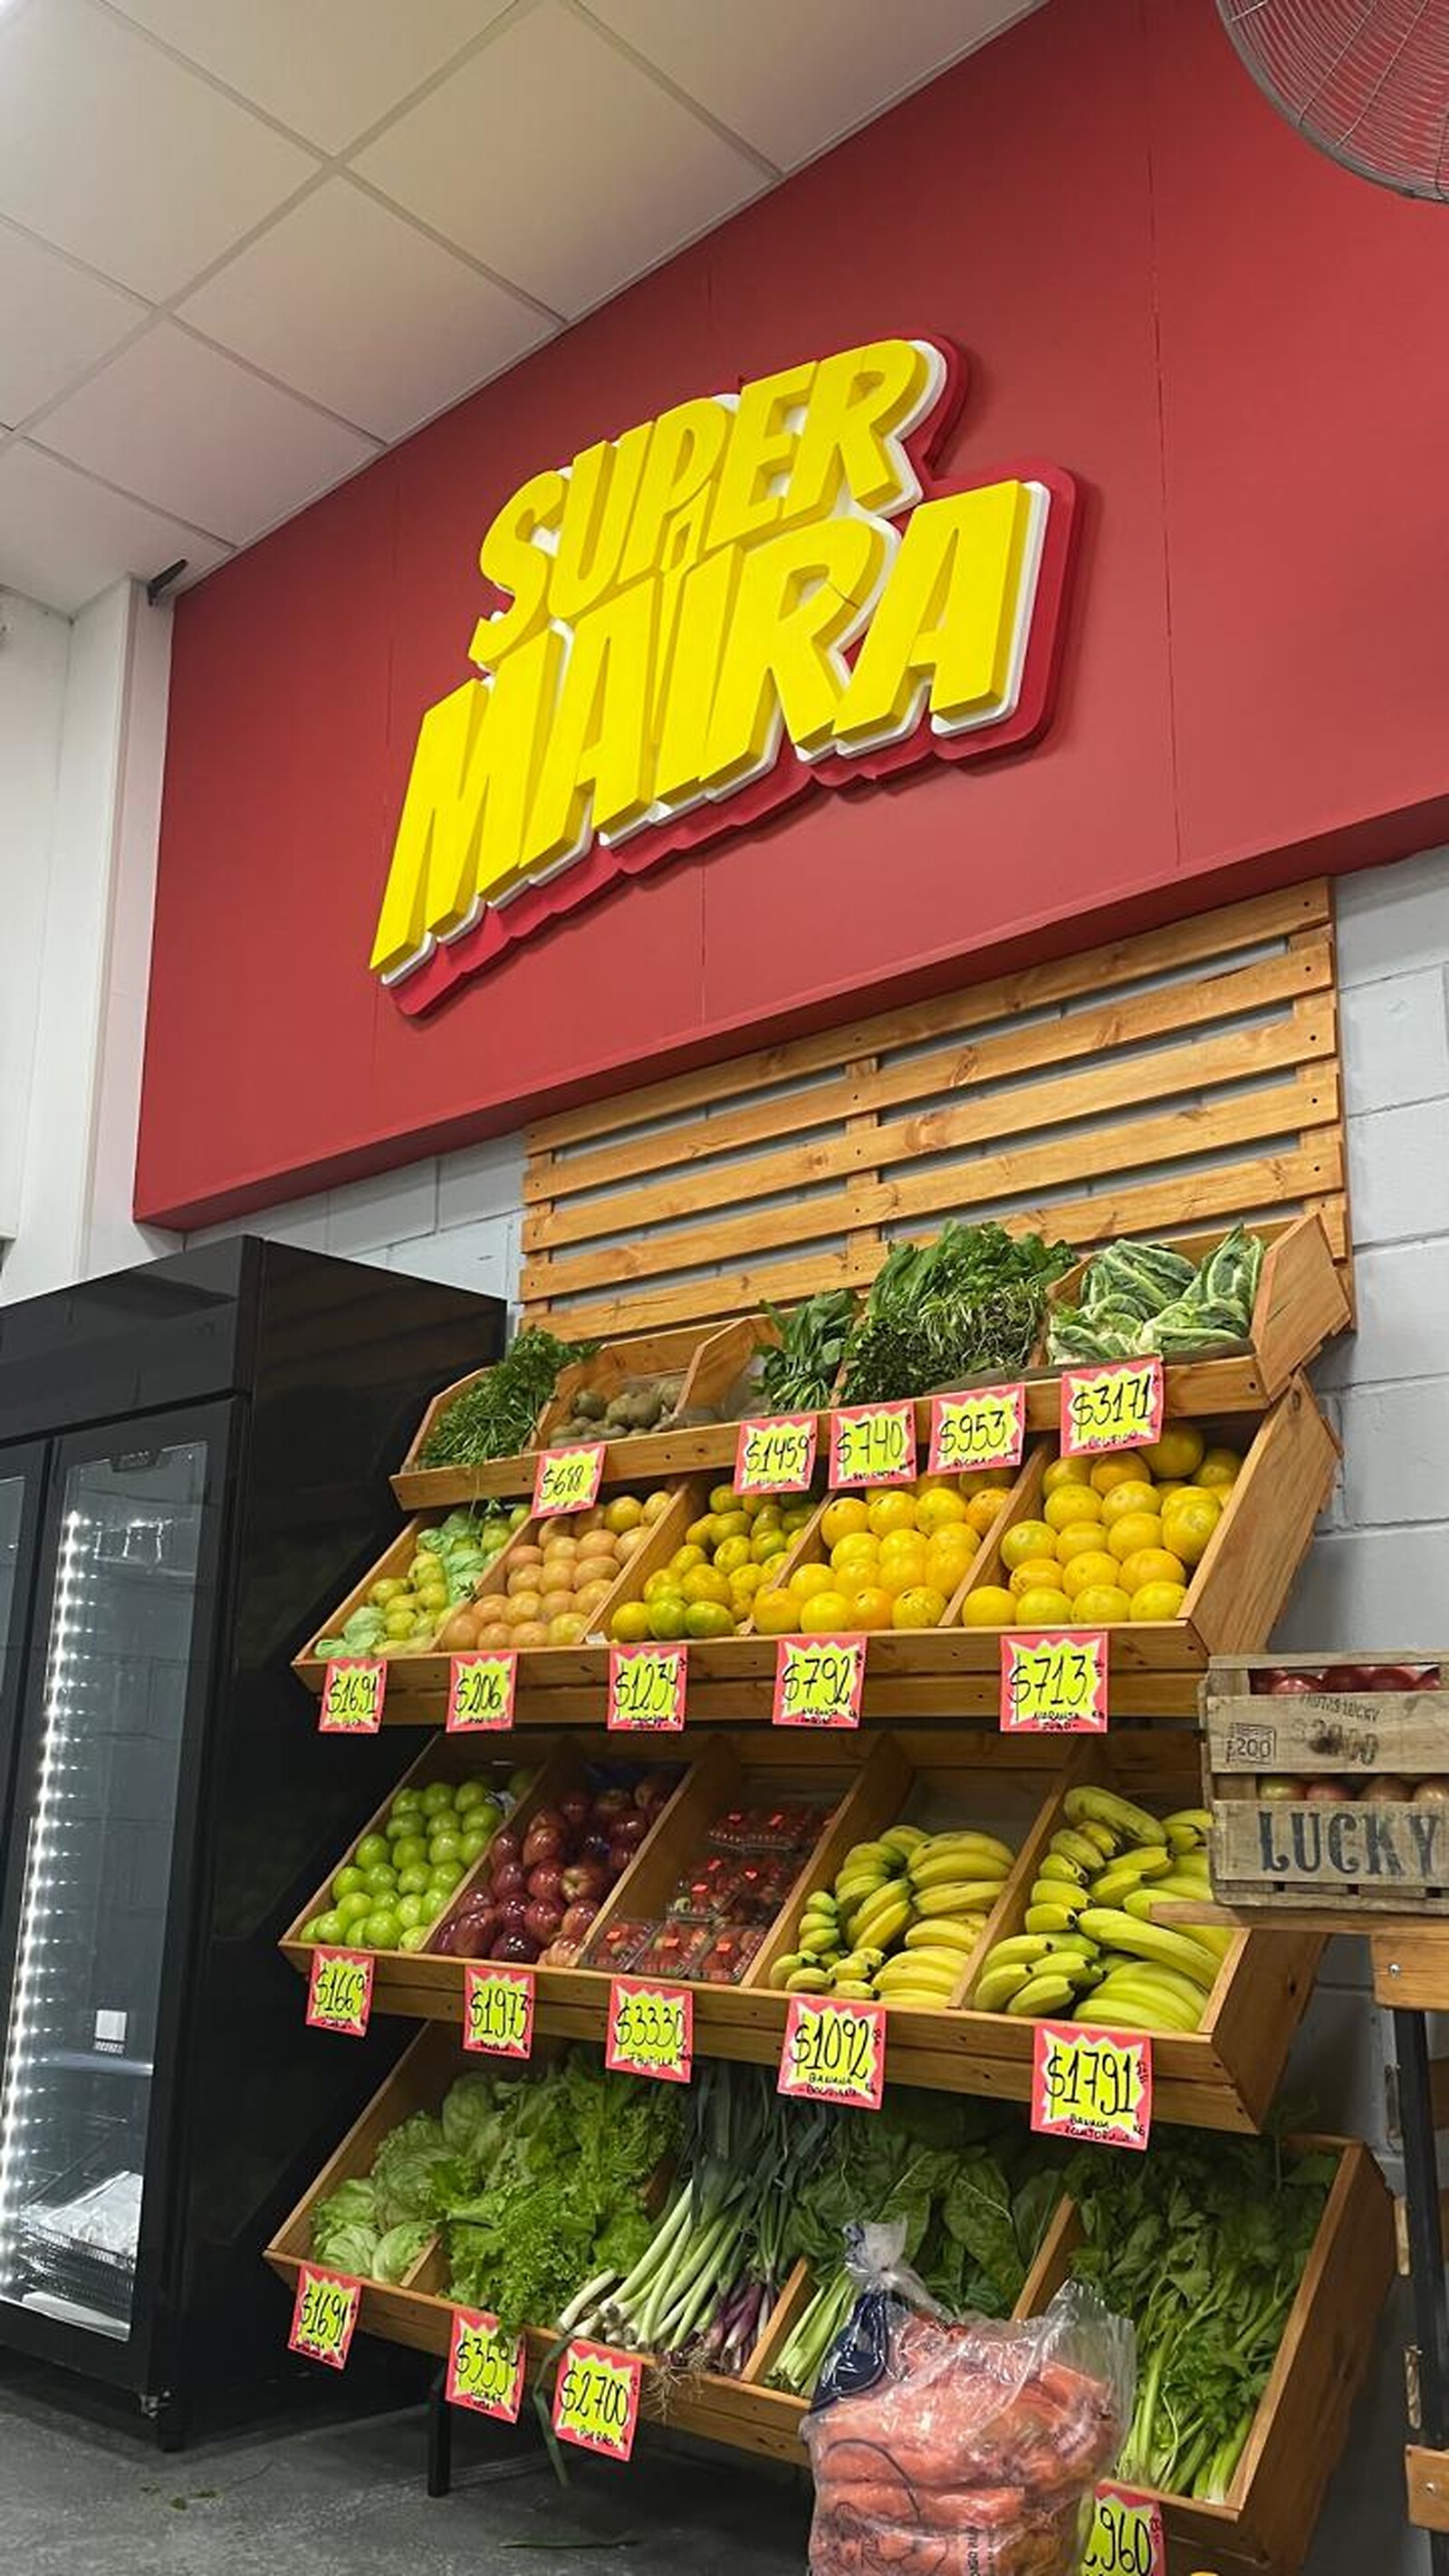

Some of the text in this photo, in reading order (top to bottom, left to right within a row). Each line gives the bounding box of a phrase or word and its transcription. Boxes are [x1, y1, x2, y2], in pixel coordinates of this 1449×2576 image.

[469, 339, 922, 663] SUPER
[937, 1409, 1006, 1460] $953
[1072, 1372, 1152, 1440] $3171
[744, 1431, 810, 1481] $1459
[836, 1419, 903, 1475] $740
[782, 1653, 851, 1711] $792
[1008, 1653, 1088, 1721] $713
[1258, 1811, 1442, 1879] LUCKY
[613, 1995, 686, 2056] $3330
[789, 2013, 868, 2079] $1092
[1044, 2043, 1135, 2119] $1791
[558, 2357, 629, 2427] $2700
[1084, 2507, 1152, 2575] 960
